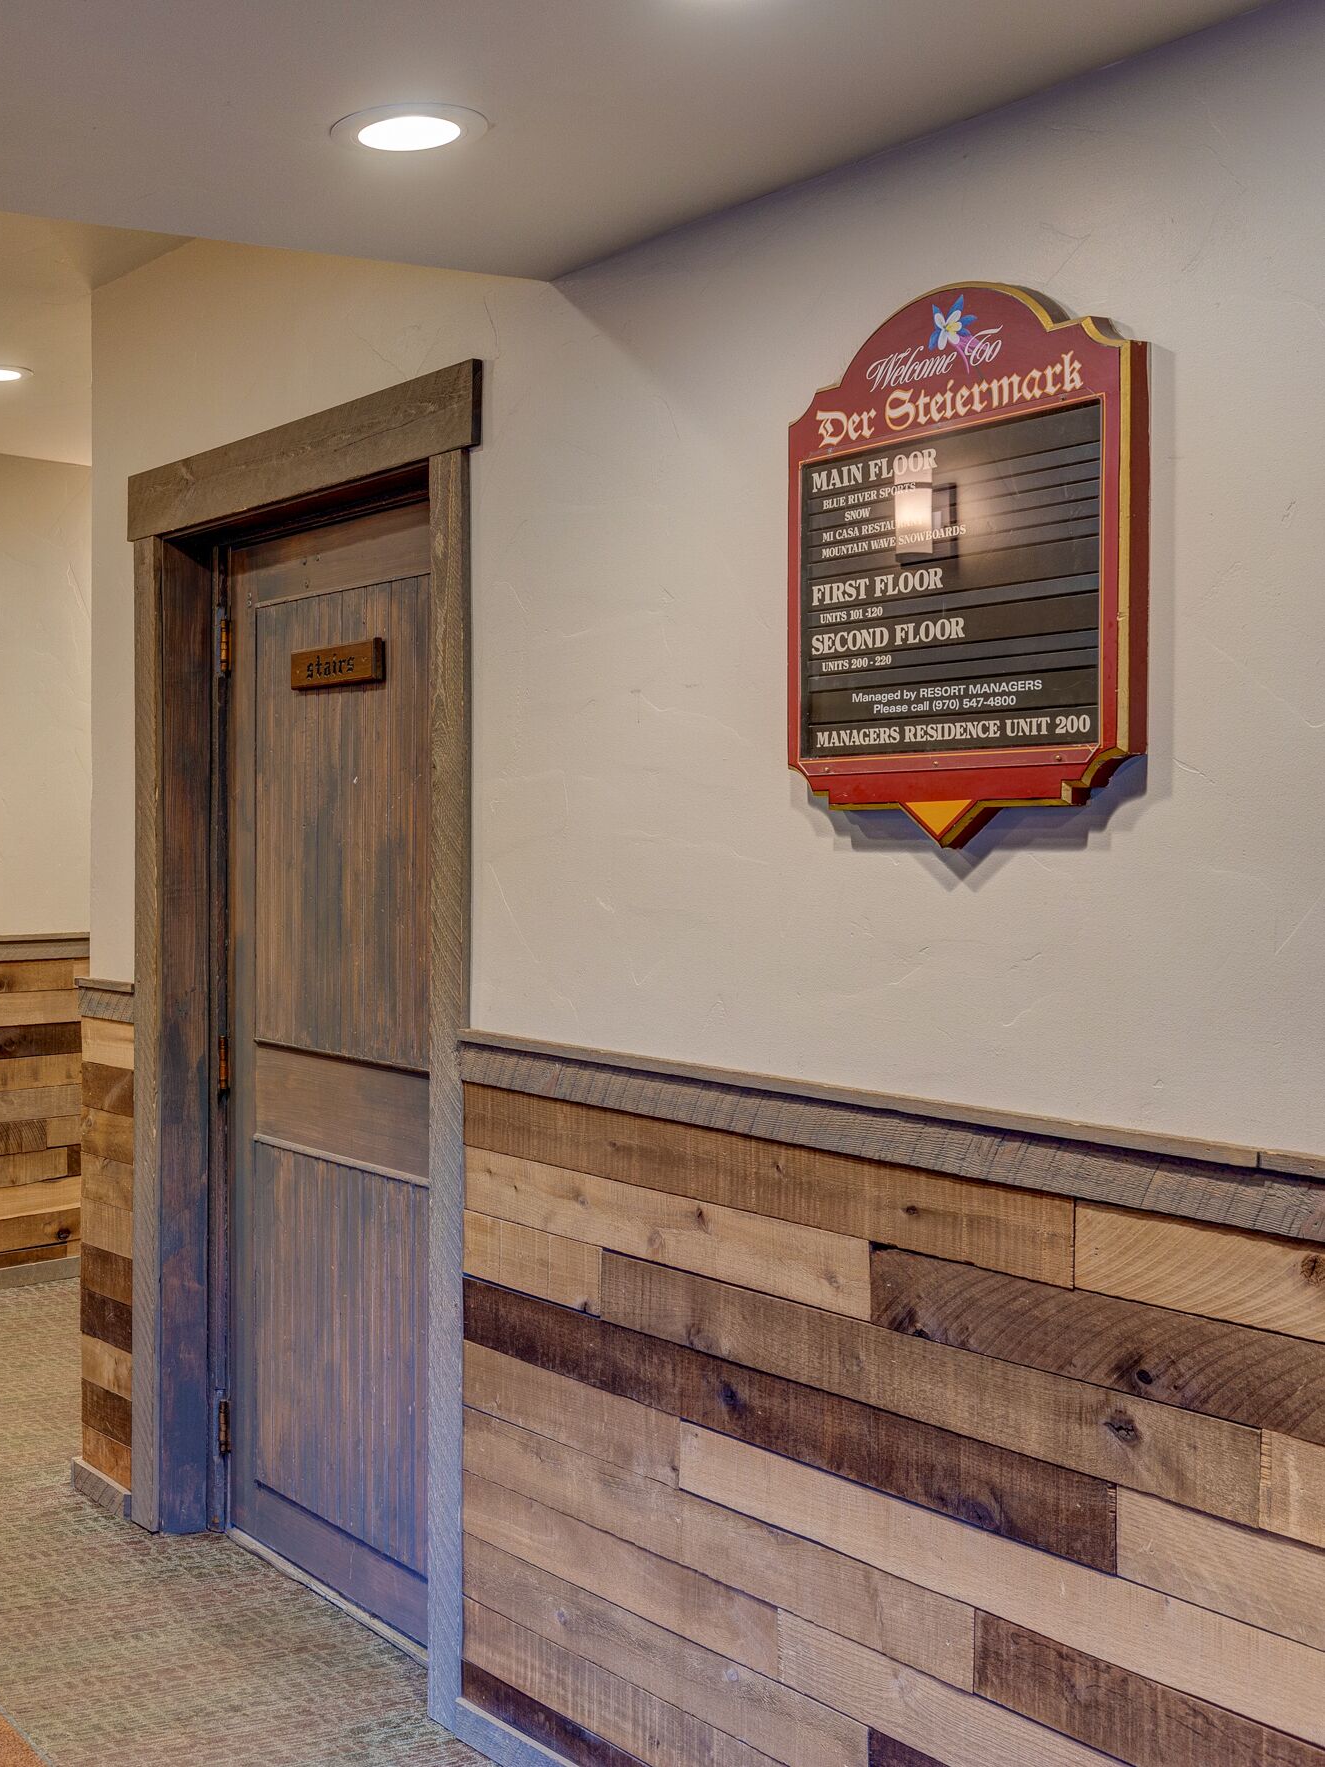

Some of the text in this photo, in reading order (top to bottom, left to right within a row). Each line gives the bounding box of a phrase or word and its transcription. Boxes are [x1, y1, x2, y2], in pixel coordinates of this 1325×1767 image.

[866, 324, 1003, 393] Welcome To
[815, 350, 1084, 449] Der Steiermark
[812, 448, 938, 493] MAIN FLOOR
[823, 482, 916, 510] BLUE RIVER SPORTS
[844, 507, 871, 522] SNOW
[821, 524, 967, 559] MOUNTAIN WAVE SNOWBOARDS
[822, 532, 834, 543] MI
[836, 527, 859, 541] CASA
[812, 567, 943, 606] FIRST FLOOR
[820, 611, 847, 624] UNITS
[849, 610, 863, 620] 101
[811, 617, 965, 655] SECOND FLOOR
[306, 653, 355, 679] stairs
[822, 659, 849, 672] UNITS
[851, 656, 869, 669] 200
[875, 654, 892, 667] 220
[851, 679, 1043, 703] Managed by RESORT MANAGERS
[873, 695, 1017, 714] Please call (970) 547-4800
[816, 714, 1091, 748] MANAGERS RESIDENCE UNIT 200
